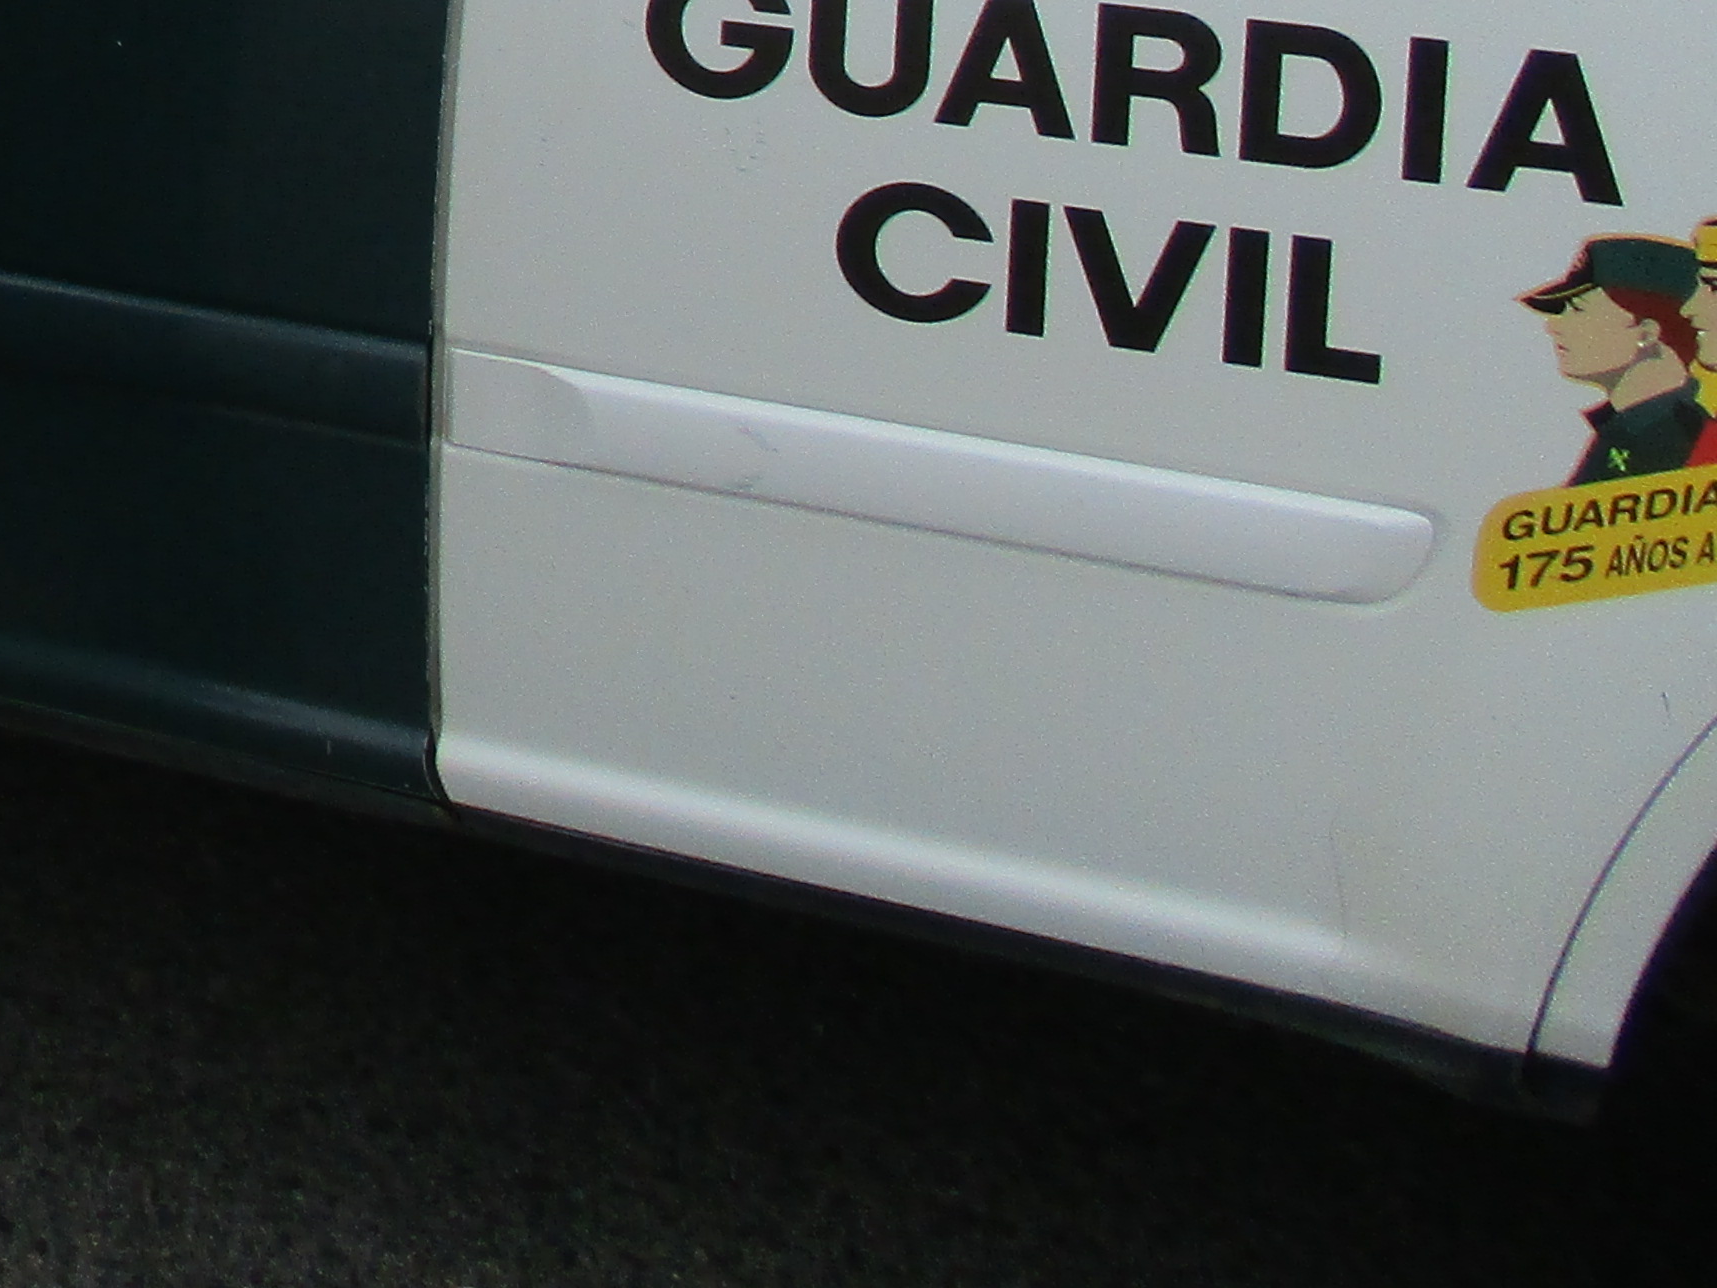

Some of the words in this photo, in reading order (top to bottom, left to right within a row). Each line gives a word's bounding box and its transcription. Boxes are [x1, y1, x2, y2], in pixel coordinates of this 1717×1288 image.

[836, 182, 1383, 384] CIVIL
[1501, 479, 1717, 542] GUARDIA
[1499, 545, 1594, 591] 175
[1605, 534, 1690, 579] AÑOS
